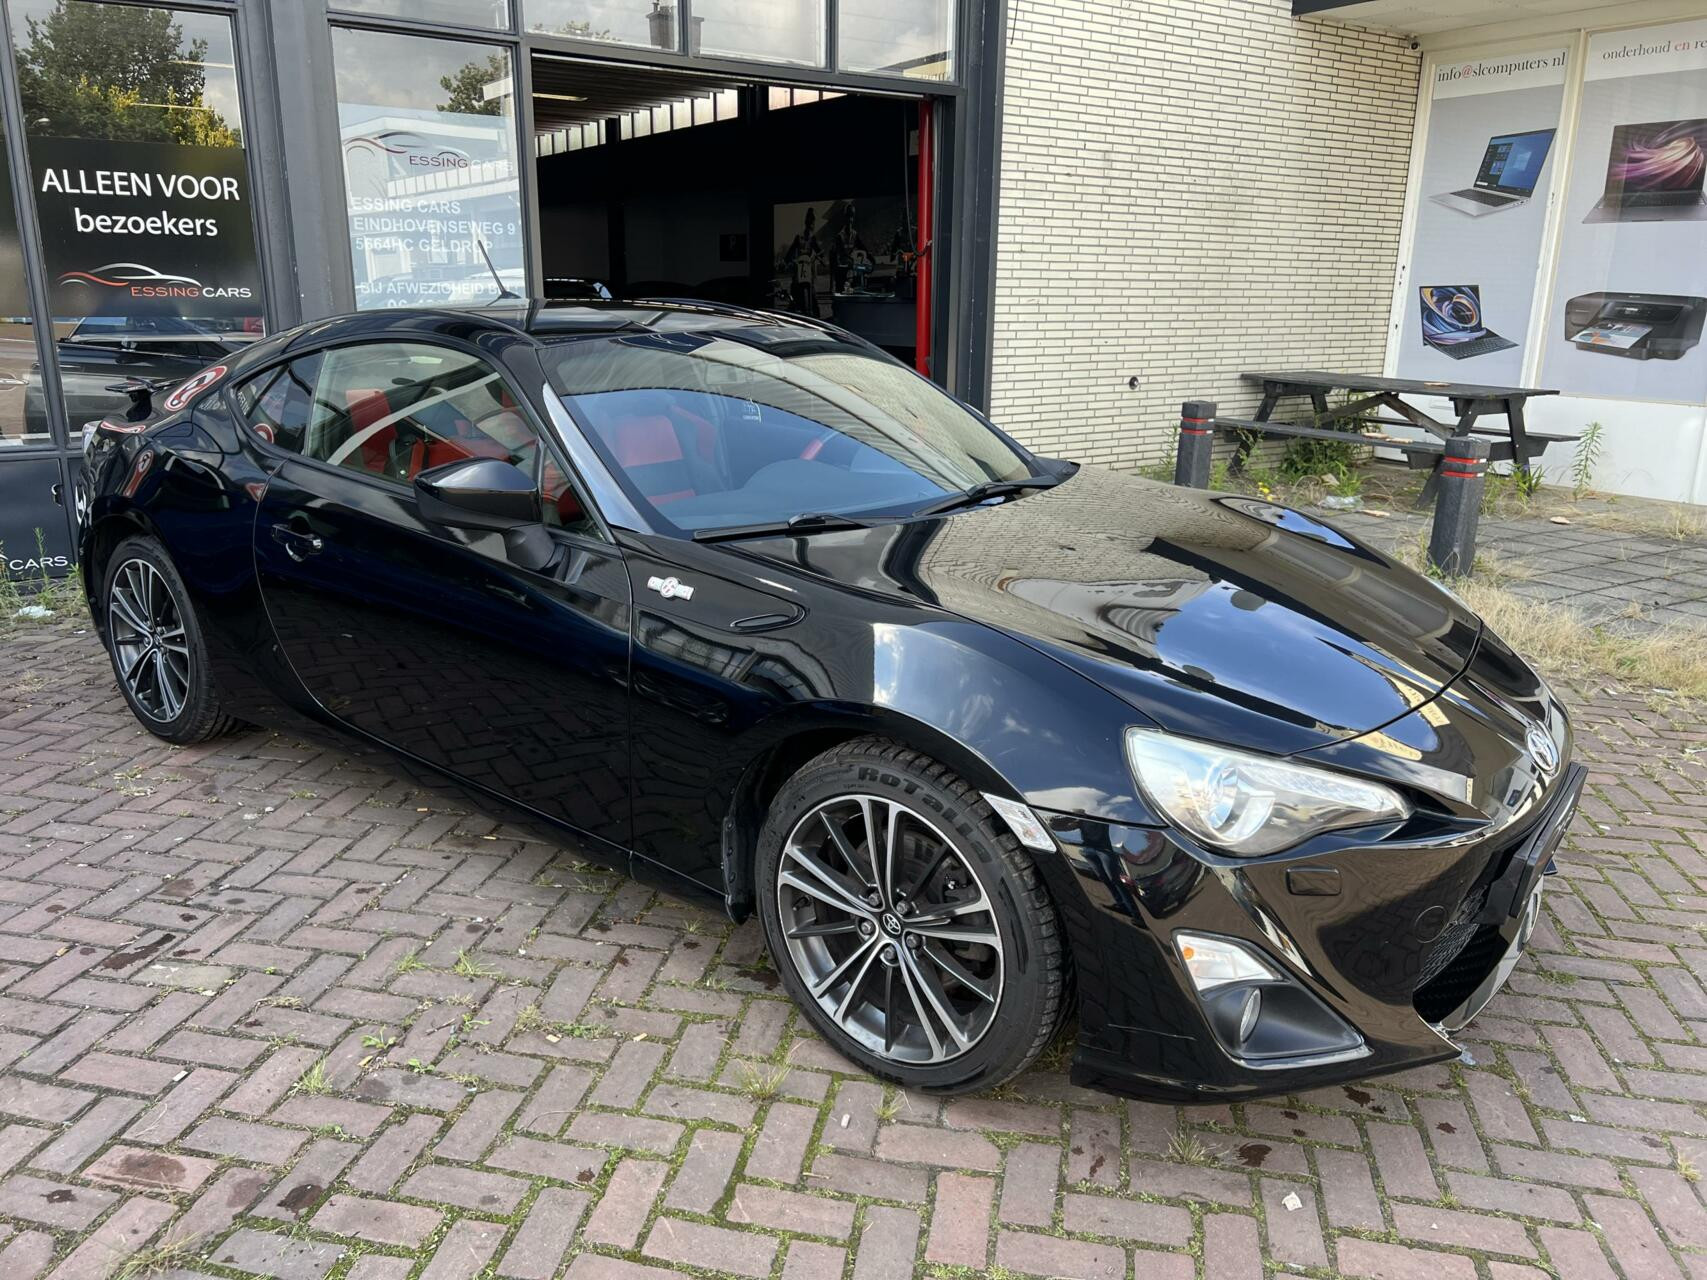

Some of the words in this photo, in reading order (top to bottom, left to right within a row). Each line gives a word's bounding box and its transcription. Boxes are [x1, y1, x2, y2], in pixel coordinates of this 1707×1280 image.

[1602, 40, 1671, 60] onderhoud
[1674, 41, 1690, 52] en
[409, 155, 468, 168] ESSING
[41, 168, 152, 197] ALLEEN
[156, 173, 240, 201] VOOR
[352, 196, 412, 212] ESSING
[417, 200, 461, 215] CARS
[74, 207, 218, 237] bezoekers
[353, 217, 504, 235] EINDHOVENSEWEG
[507, 223, 516, 236] 9
[131, 286, 199, 297] ESSING
[202, 287, 252, 298] CARS
[9, 556, 68, 571] CARS
